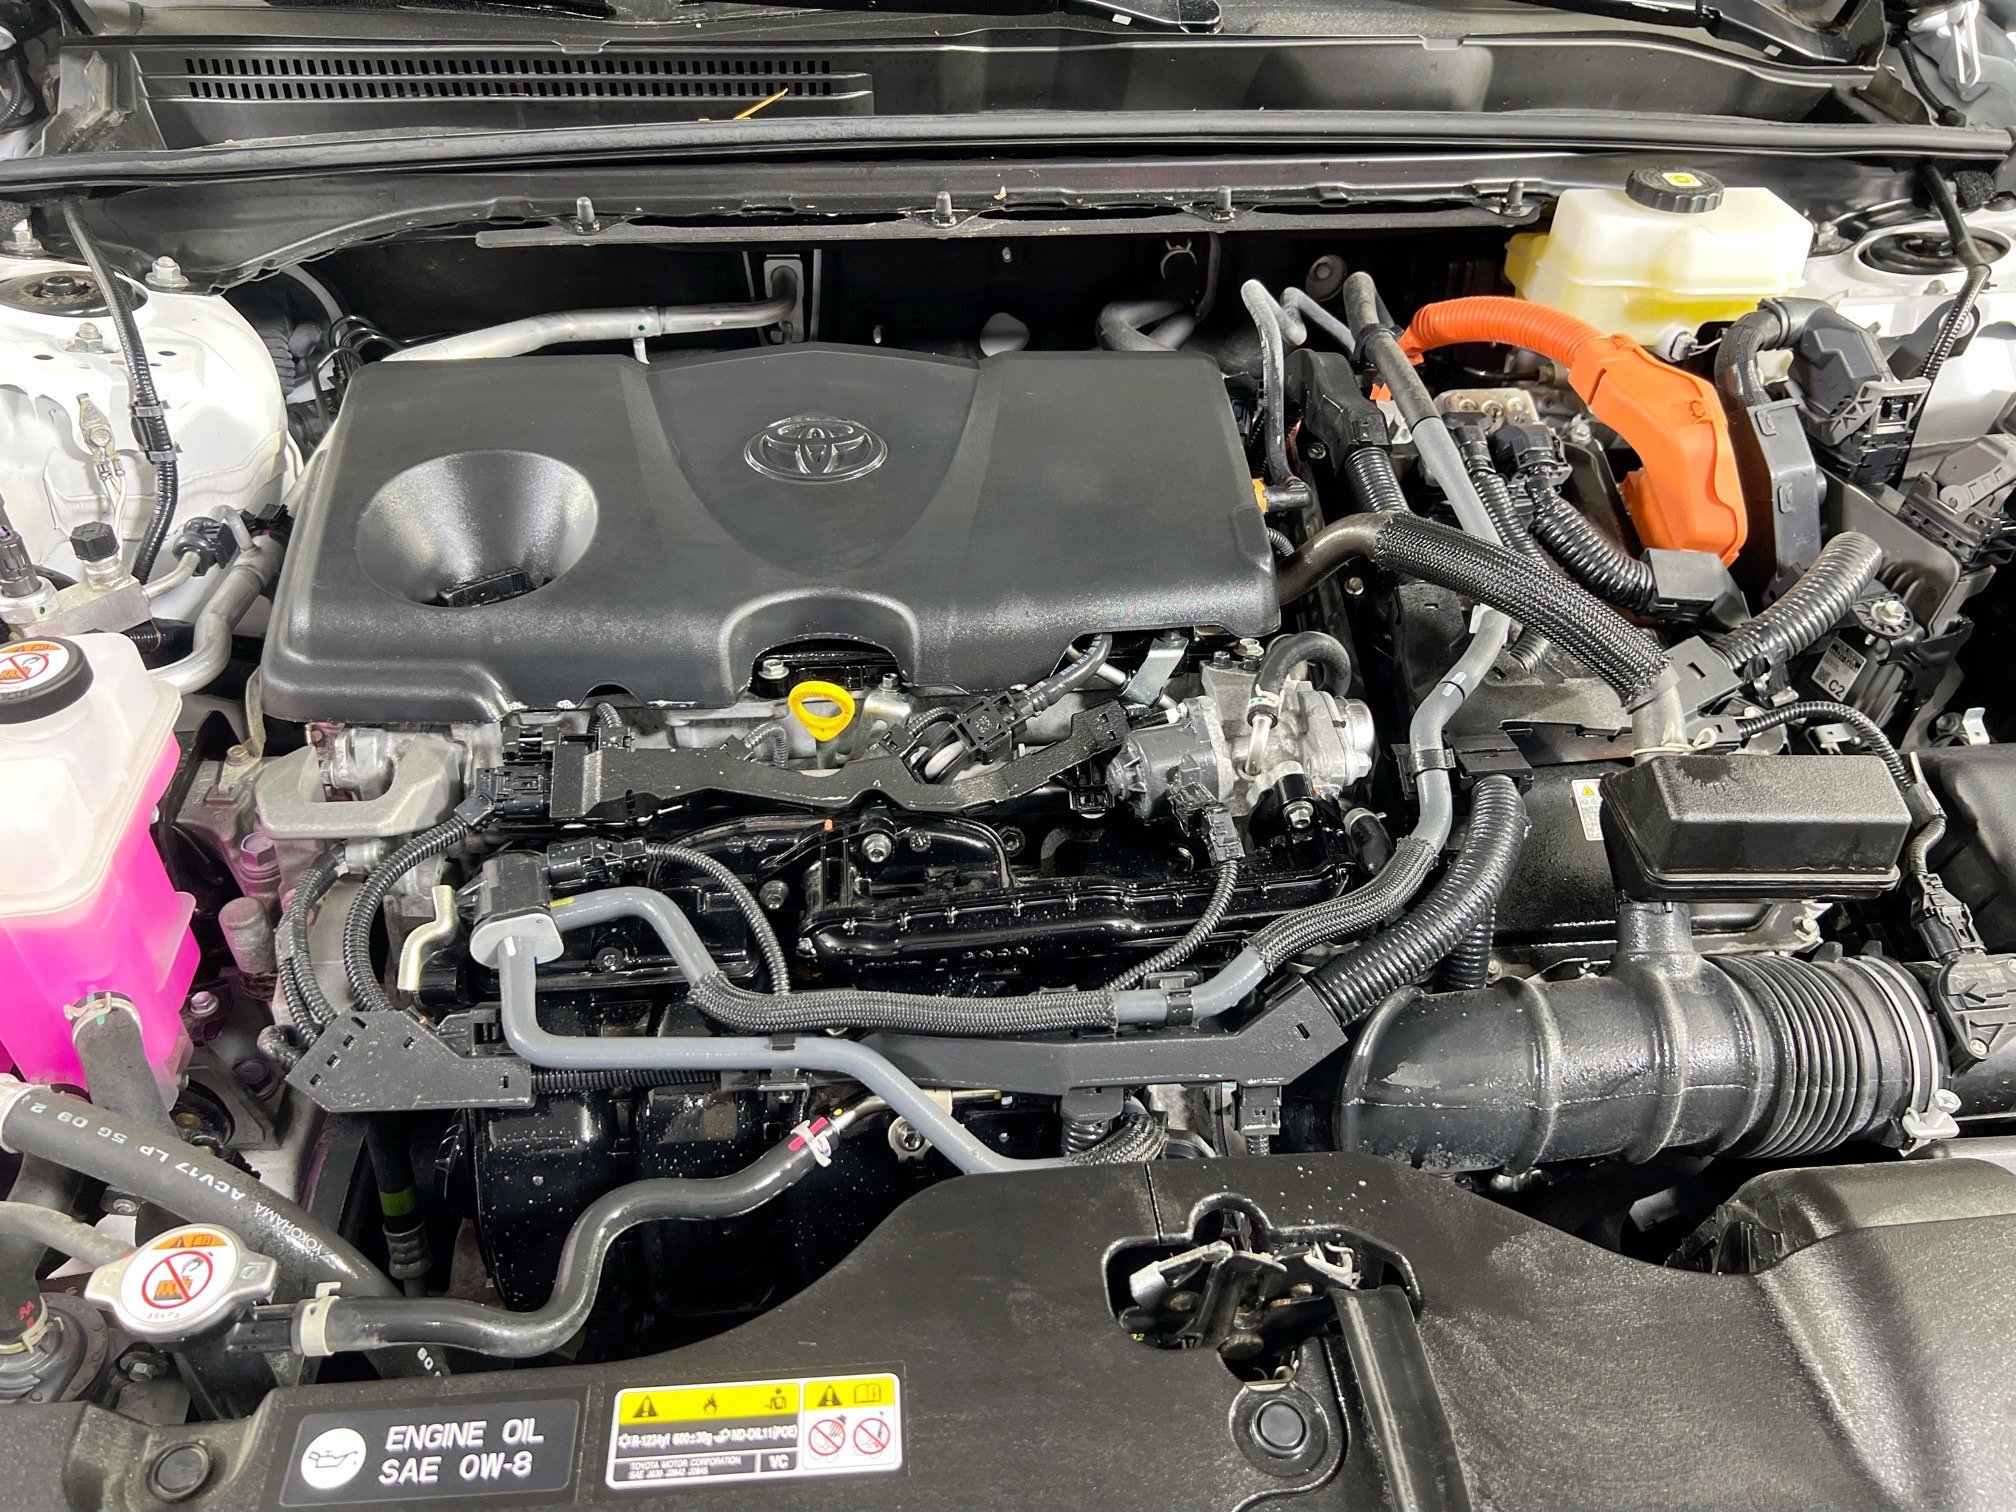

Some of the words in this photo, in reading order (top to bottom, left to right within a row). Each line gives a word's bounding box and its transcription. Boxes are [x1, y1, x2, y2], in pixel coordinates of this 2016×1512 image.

[1829, 680, 1845, 698] C2
[139, 1145, 170, 1163] LP
[175, 1162, 246, 1201] ACV17
[254, 1201, 323, 1255] YOKOHAMA
[385, 1420, 487, 1451] ENGINE
[502, 1417, 544, 1445] OIL
[378, 1455, 442, 1486] SAE
[459, 1450, 533, 1481] 0W-8
[630, 1461, 660, 1470] TOYOTA
[662, 1459, 688, 1468] MOTOR
[690, 1455, 741, 1467] CORPORATION
[768, 1454, 790, 1469] VC
[628, 1470, 645, 1480] SAE
